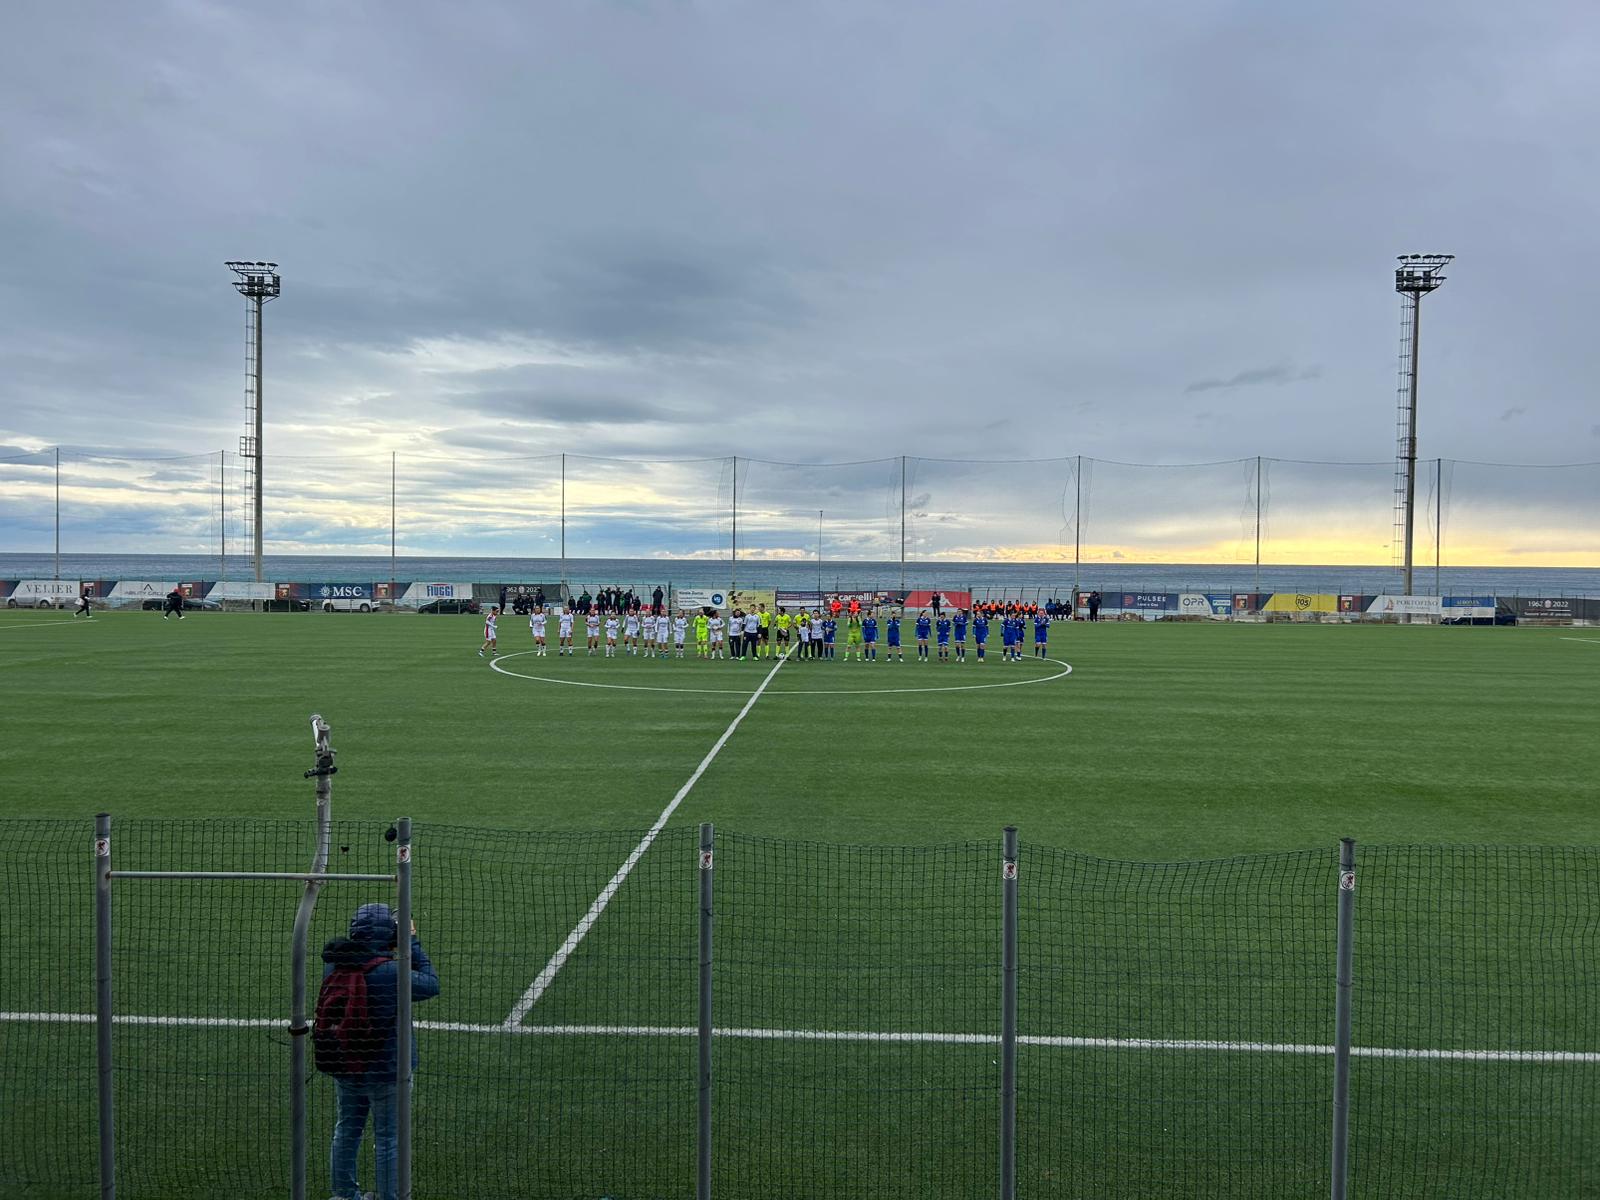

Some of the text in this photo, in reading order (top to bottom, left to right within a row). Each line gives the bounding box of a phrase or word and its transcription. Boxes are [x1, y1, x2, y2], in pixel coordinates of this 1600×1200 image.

[26, 584, 72, 594] VELIER
[332, 586, 363, 597] MSC
[426, 585, 454, 598] FIUGGI
[1182, 597, 1205, 606] OPR
[1552, 600, 1569, 608] 2022
